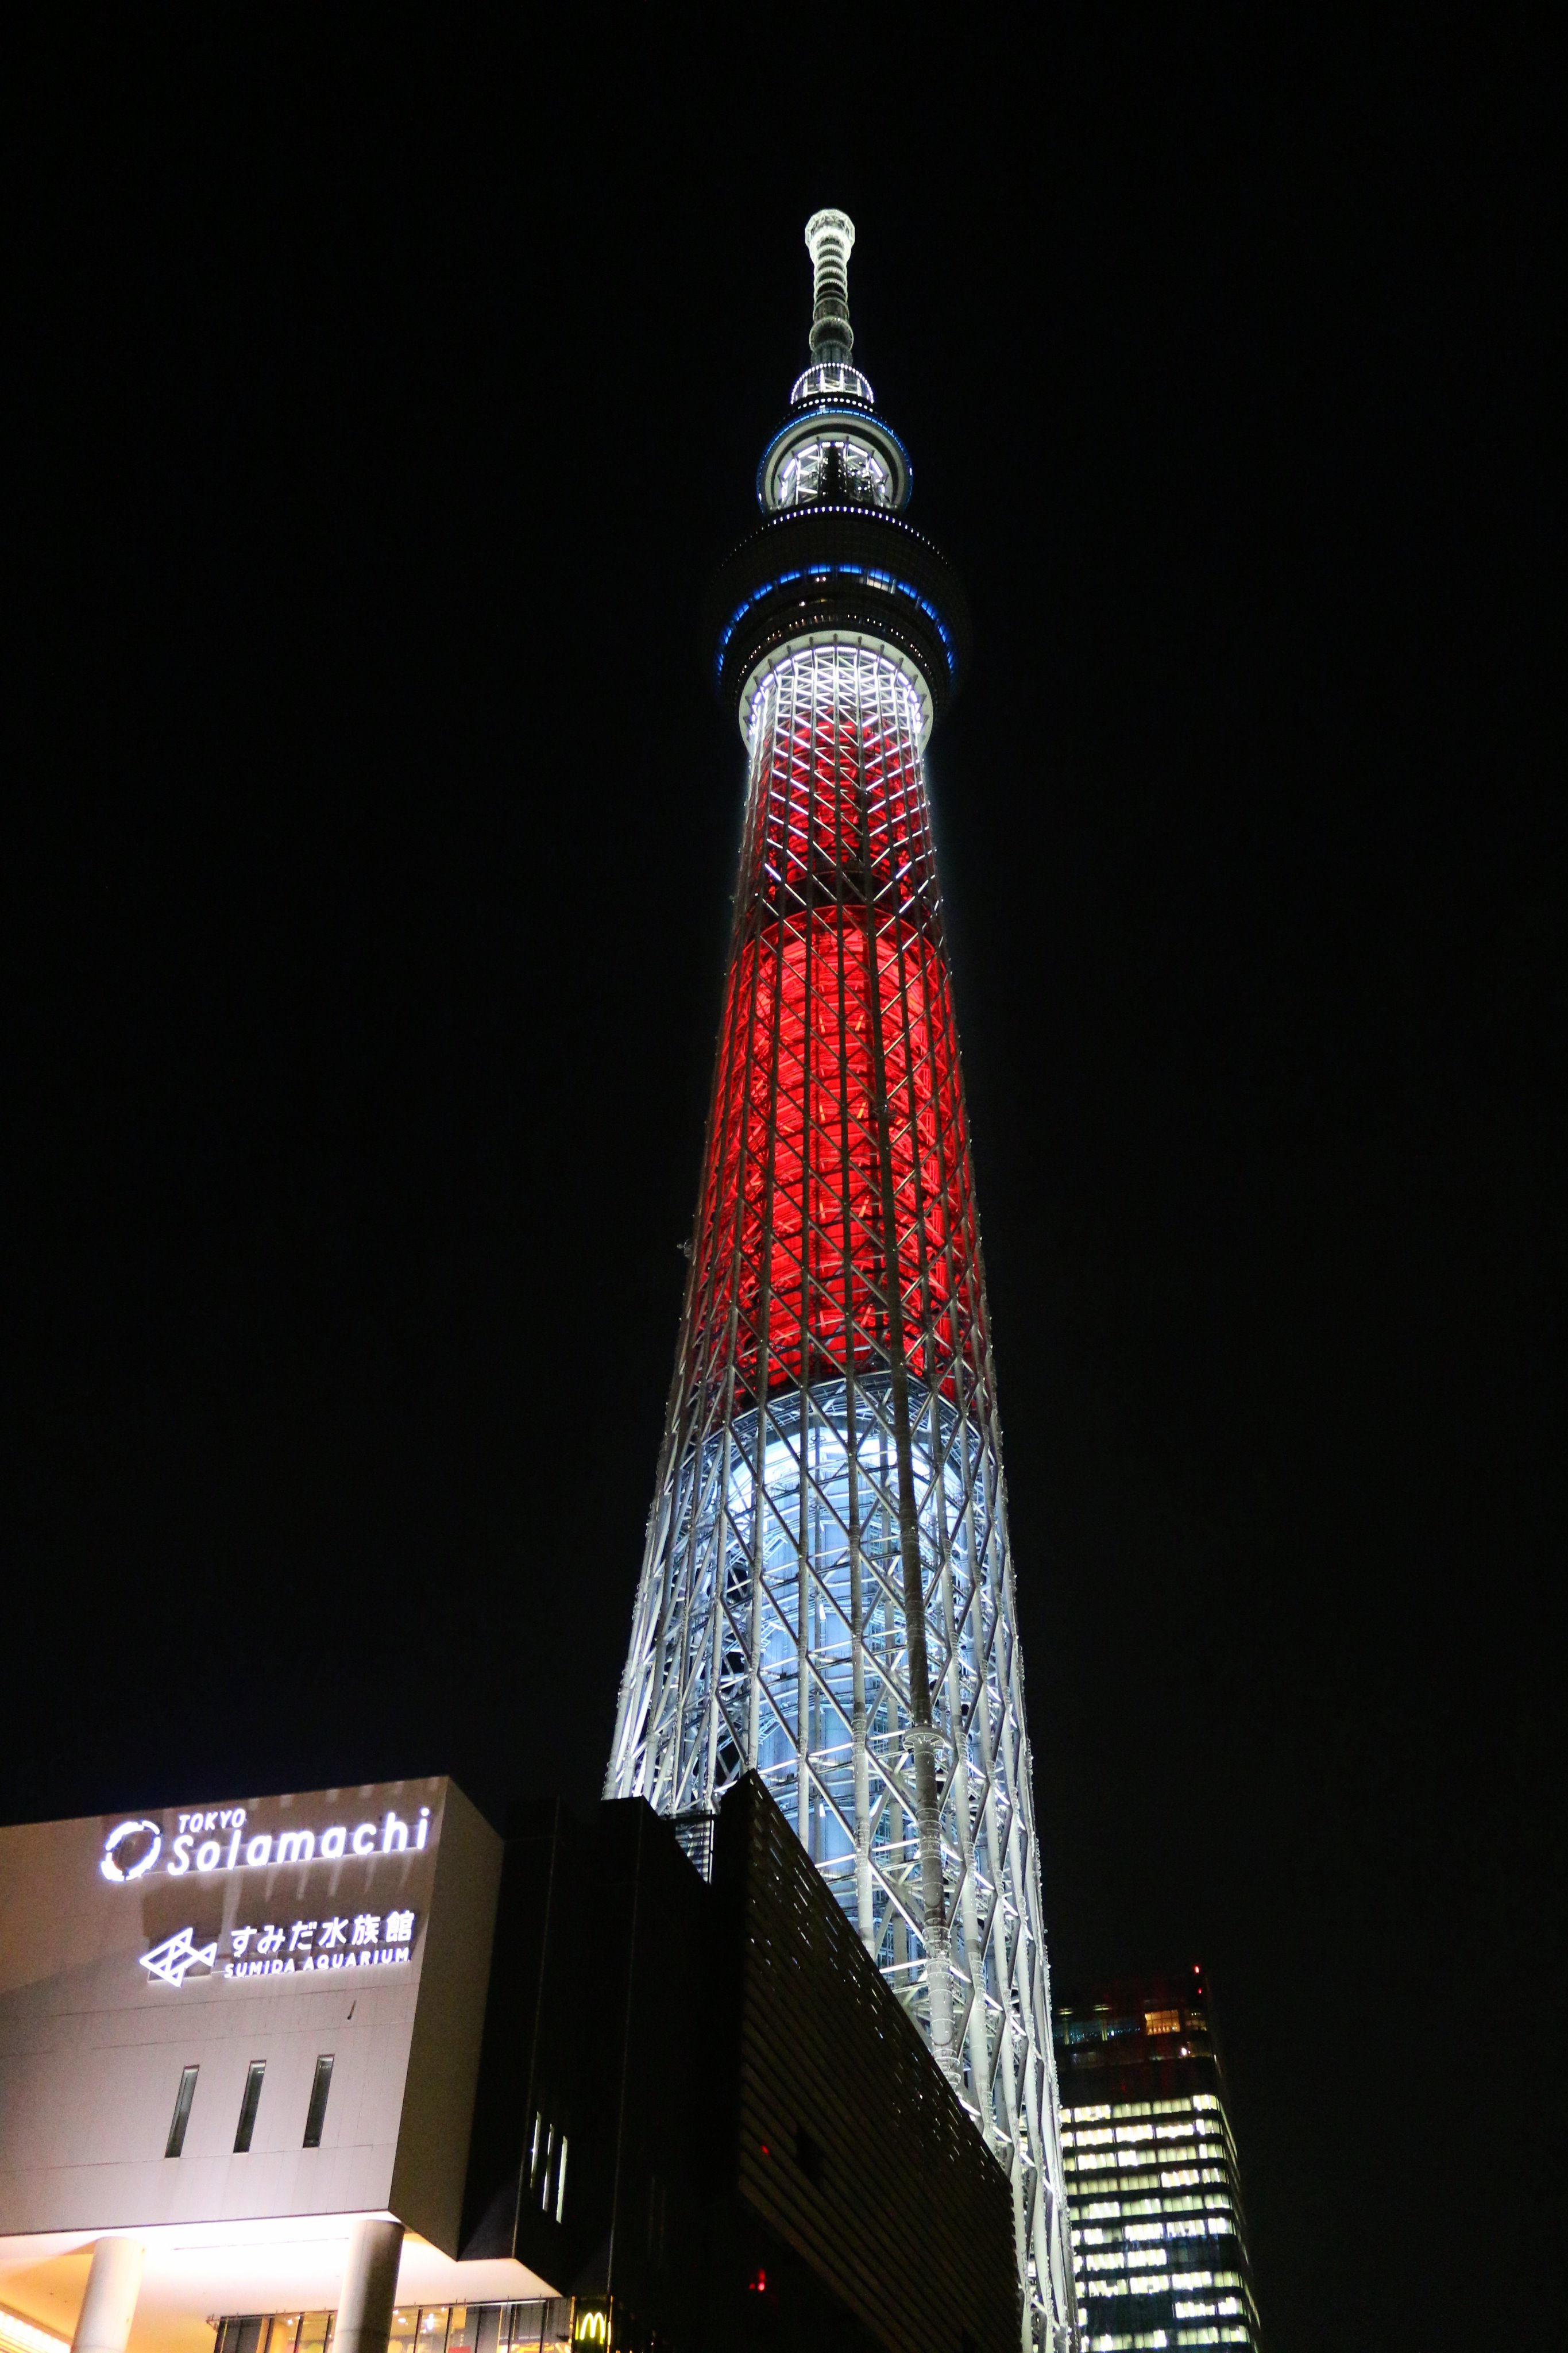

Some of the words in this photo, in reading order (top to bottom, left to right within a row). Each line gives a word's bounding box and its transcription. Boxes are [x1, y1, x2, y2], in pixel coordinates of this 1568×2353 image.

[179, 1808, 246, 1834] TOKYO
[167, 1808, 430, 1876] Solamachi
[231, 1910, 415, 1957] すみだ水族館
[224, 1958, 295, 1978] SUMIDA
[303, 1947, 410, 1971] AQUARIUM
